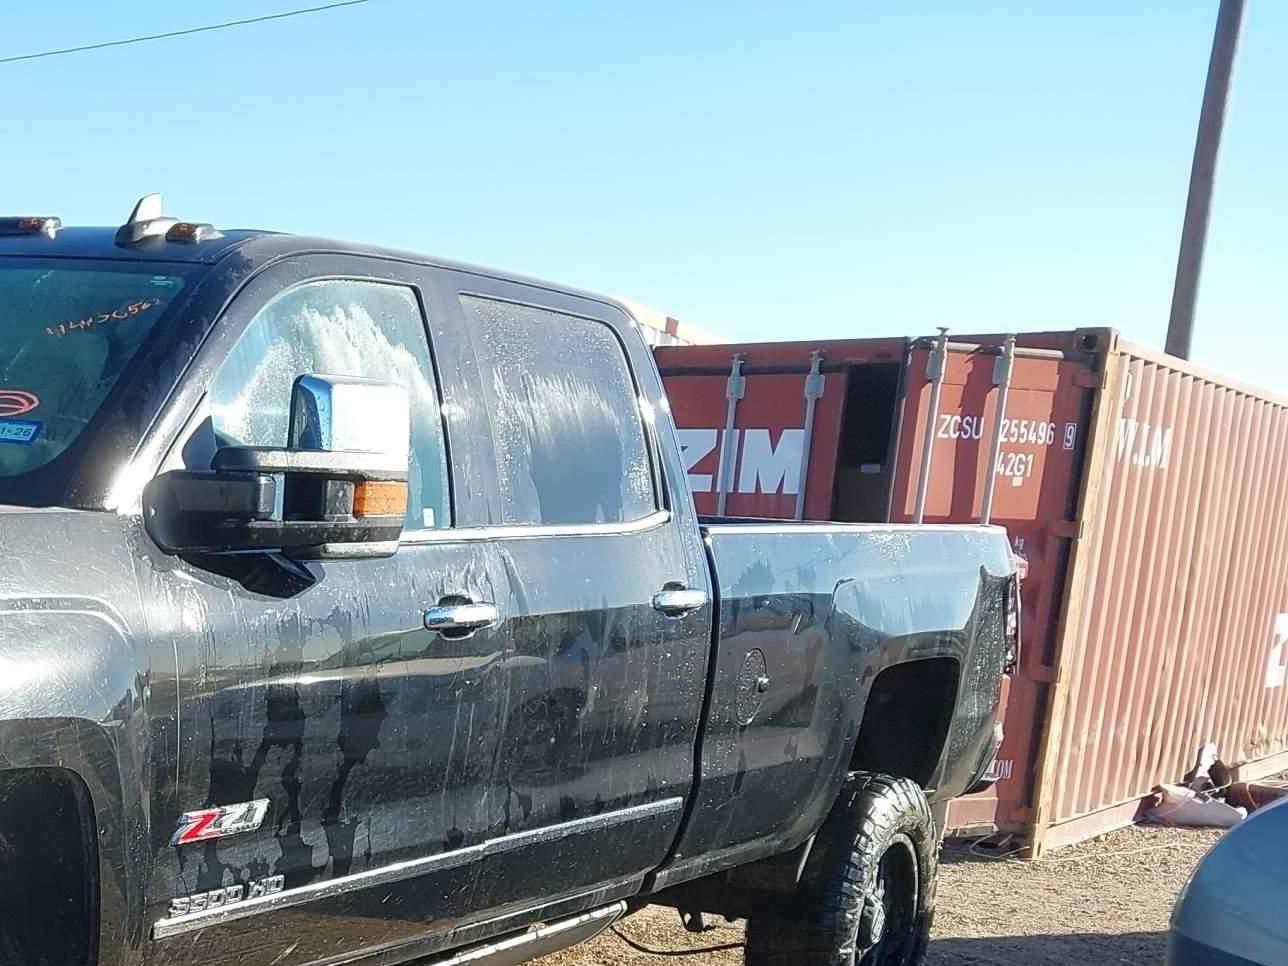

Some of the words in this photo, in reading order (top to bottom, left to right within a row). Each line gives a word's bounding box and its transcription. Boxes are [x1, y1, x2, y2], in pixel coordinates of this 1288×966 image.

[937, 414, 984, 441] ZCSU
[999, 418, 1056, 446] 255496
[1064, 422, 1076, 451] 9
[676, 428, 807, 495] ZIM
[996, 452, 1033, 478] 42G1
[170, 797, 270, 846] Z71
[247, 874, 285, 900] HD
